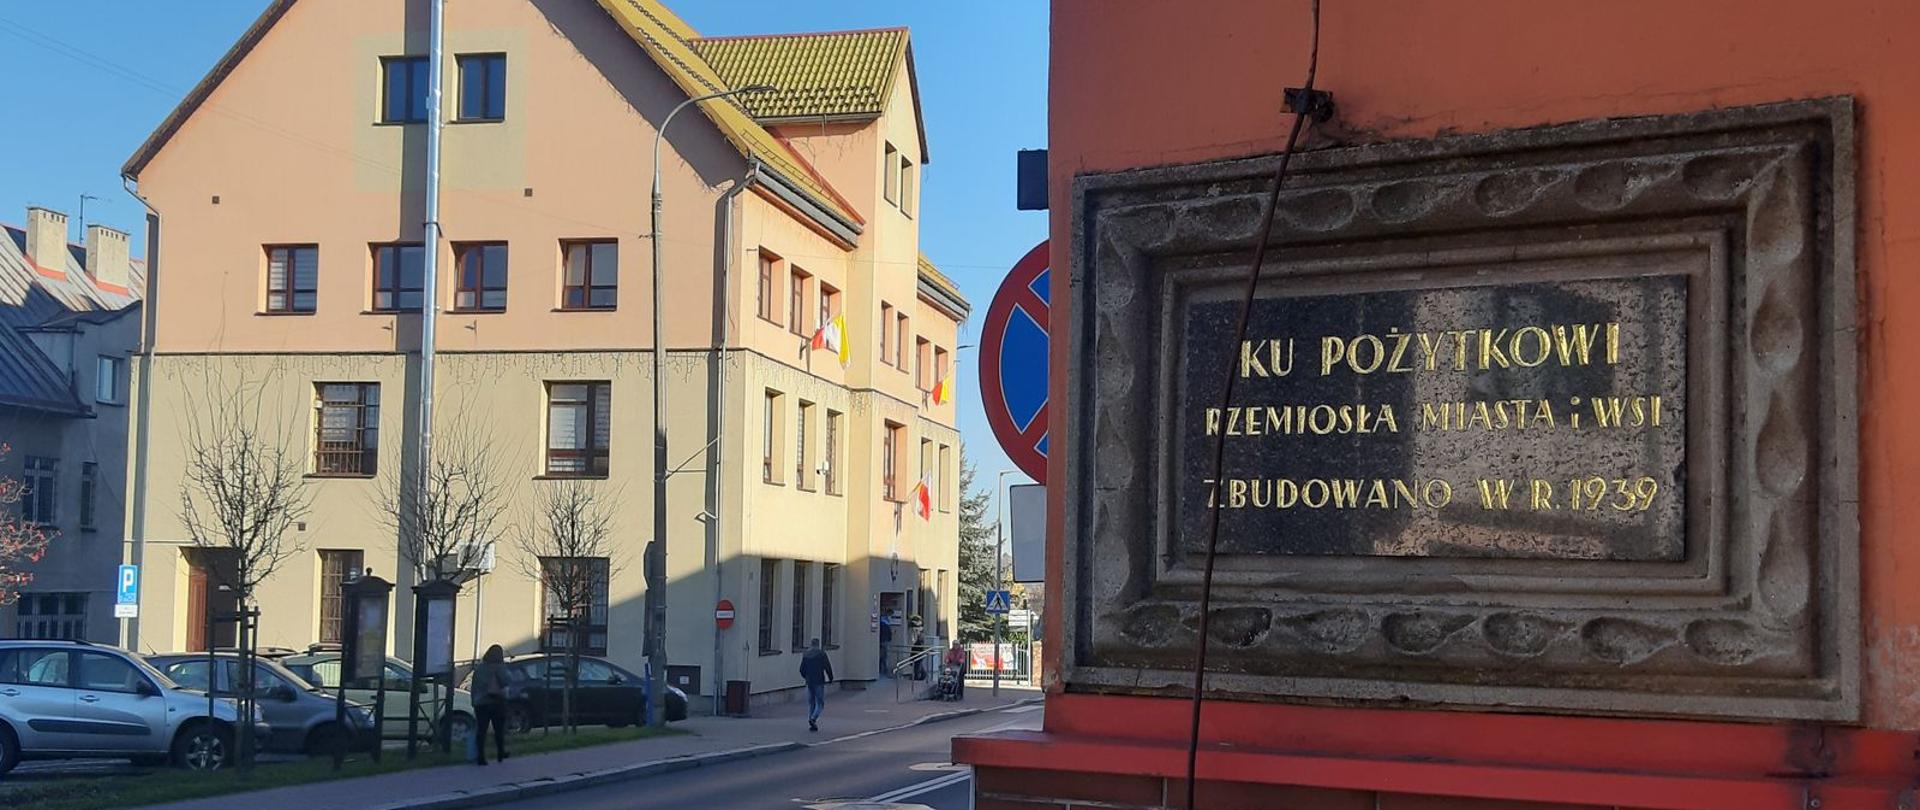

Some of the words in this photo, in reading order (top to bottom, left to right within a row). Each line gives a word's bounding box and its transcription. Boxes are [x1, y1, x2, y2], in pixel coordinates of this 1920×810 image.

[1240, 339, 1293, 378] KU
[1320, 322, 1621, 377] POŻYTKOWI
[1205, 403, 1399, 436] RZEMIOSŁA
[1422, 399, 1556, 432] MIASTA
[1591, 395, 1662, 429] WSI
[1476, 478, 1517, 511] W
[122, 569, 134, 593] P
